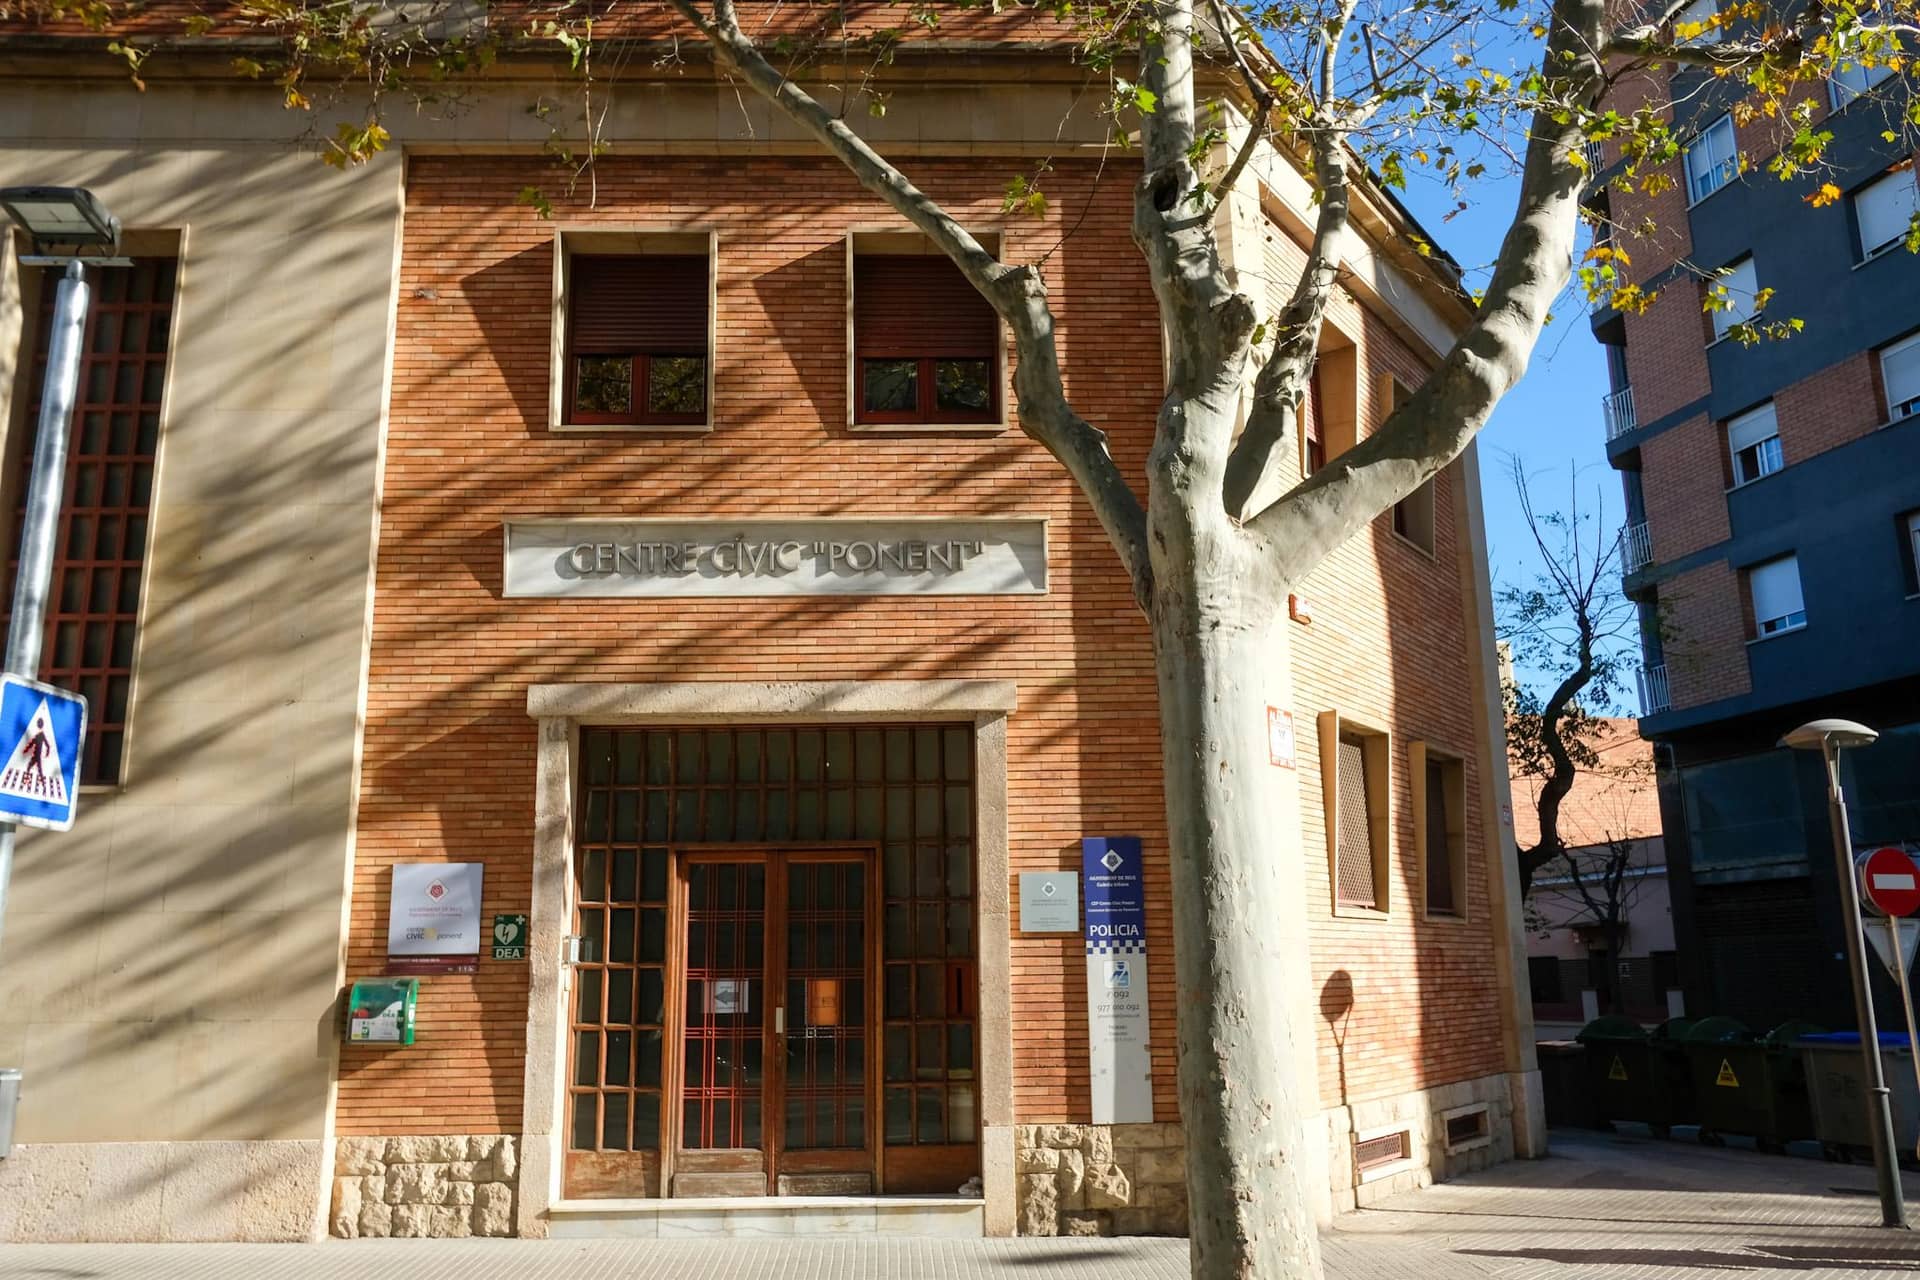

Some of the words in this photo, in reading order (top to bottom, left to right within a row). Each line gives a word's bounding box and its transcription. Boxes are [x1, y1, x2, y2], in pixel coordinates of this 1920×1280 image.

[570, 542, 698, 573] CENTRE
[711, 532, 801, 573] CÍVIC
[813, 540, 985, 572] "PONENT"
[1089, 924, 1140, 937] POLICIA
[495, 948, 521, 960] DEA
[1113, 990, 1130, 1000] 092
